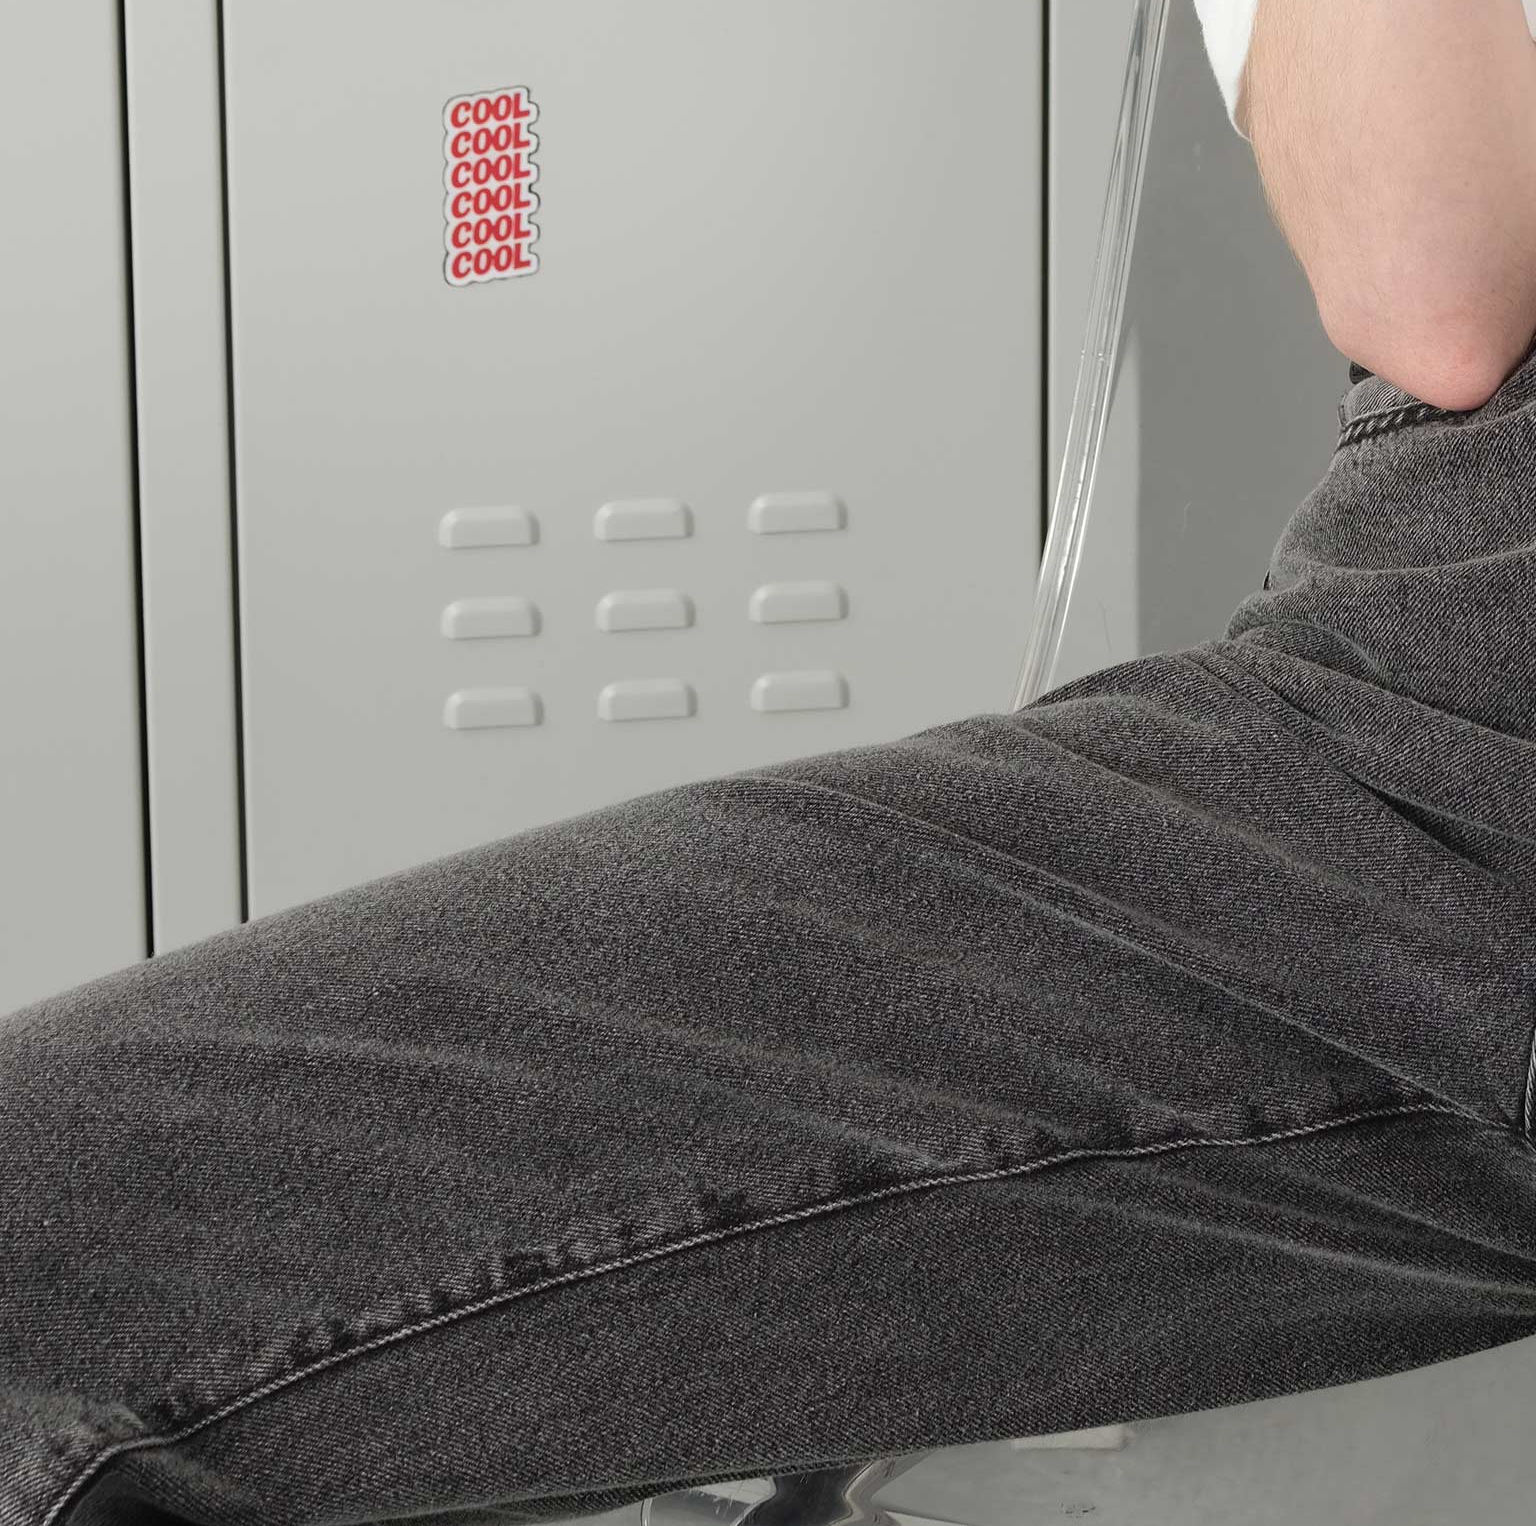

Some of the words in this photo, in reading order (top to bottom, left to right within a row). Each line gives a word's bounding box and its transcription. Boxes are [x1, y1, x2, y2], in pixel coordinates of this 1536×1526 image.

[451, 92, 530, 128] COOL
[451, 123, 530, 158] COOL
[451, 153, 531, 188] COOL
[451, 183, 531, 219] COOL
[451, 213, 531, 249] COOL
[452, 243, 531, 279] COOL
